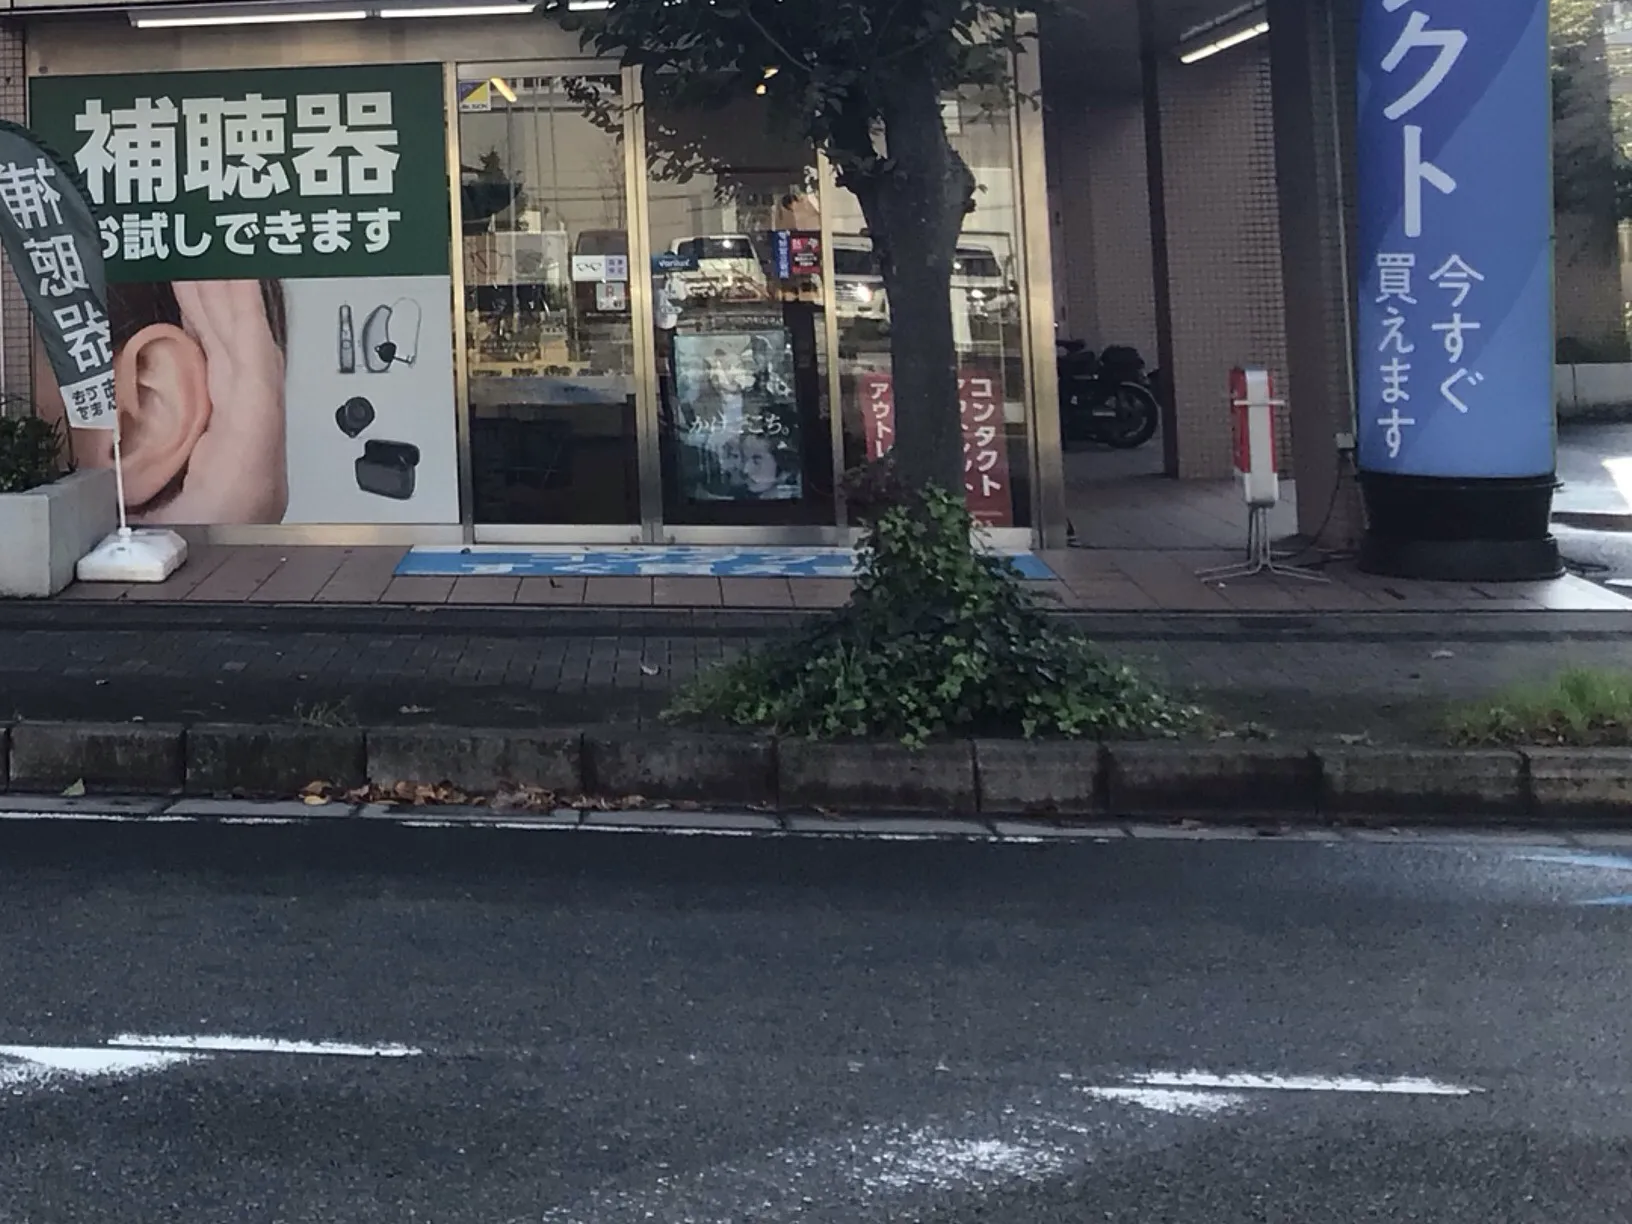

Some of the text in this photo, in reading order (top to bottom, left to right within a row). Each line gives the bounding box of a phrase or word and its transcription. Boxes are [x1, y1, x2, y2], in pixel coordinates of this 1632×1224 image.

[72, 91, 401, 205] 補聴器
[1375, 252, 1418, 459] 買えます
[1429, 253, 1485, 414] 今すぐ
[970, 378, 1002, 498] コンタクト
